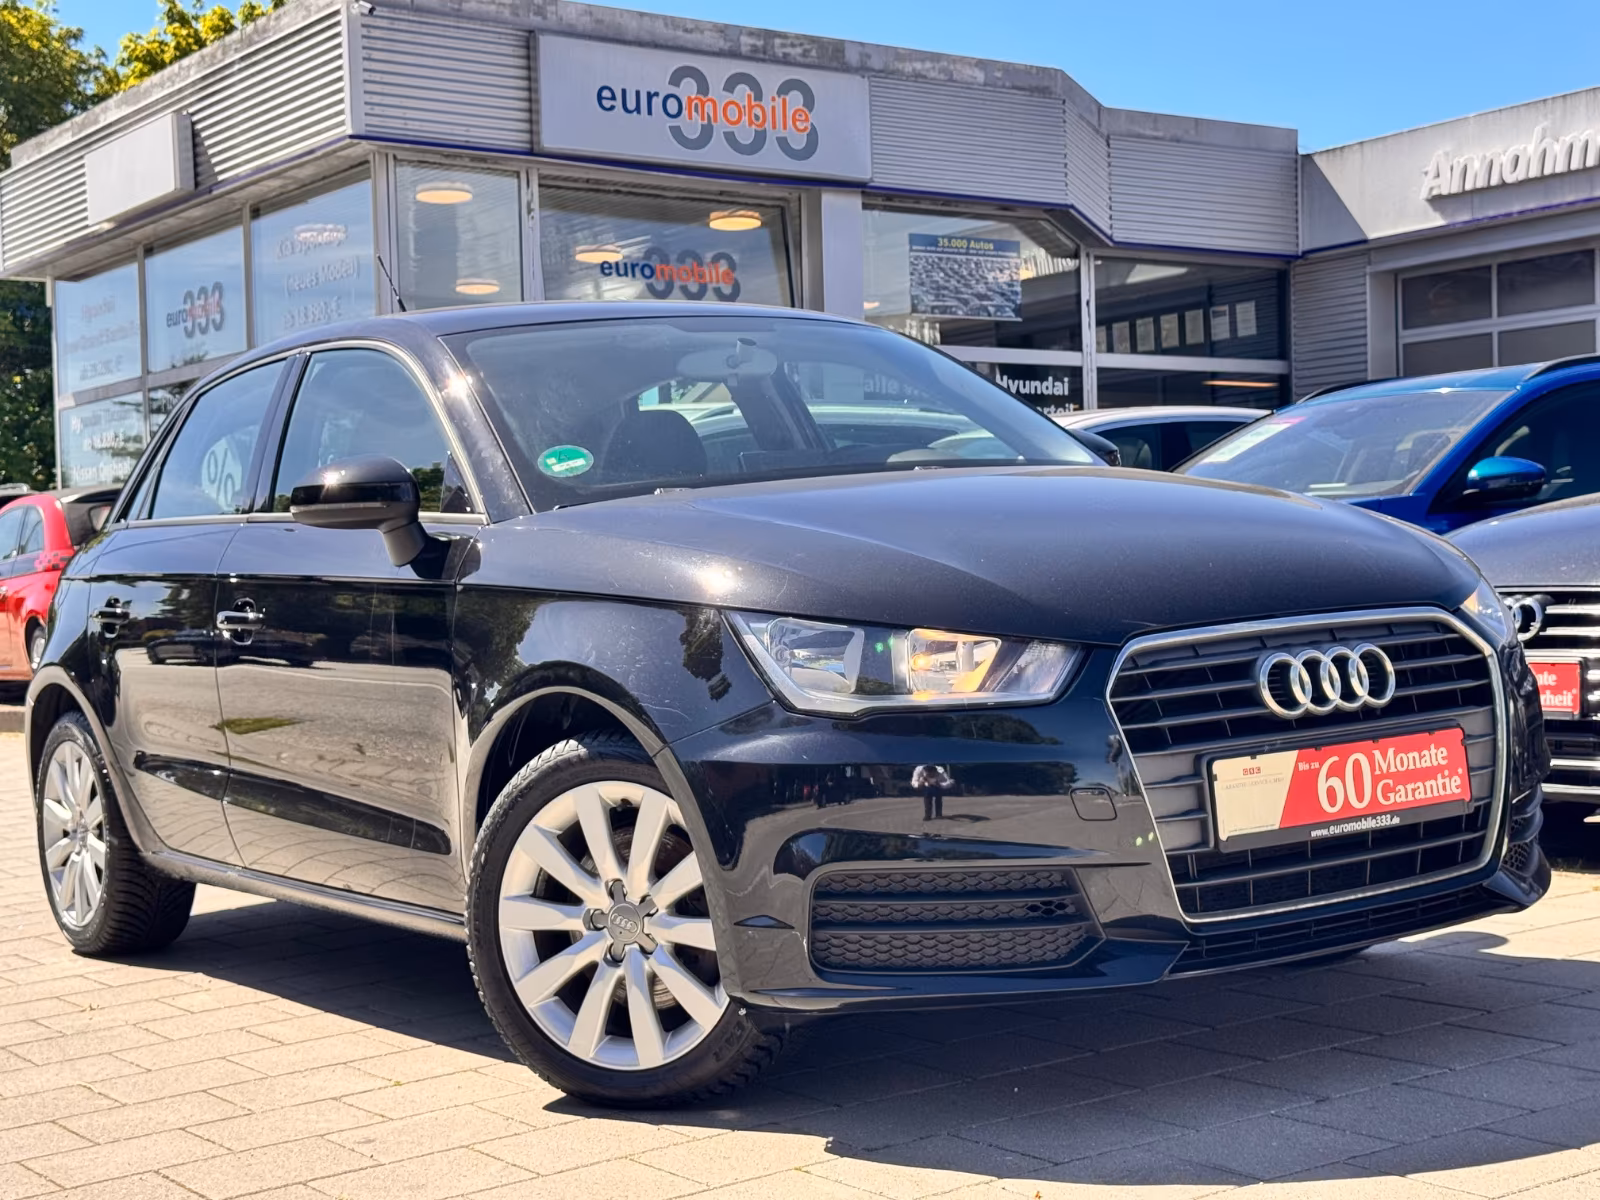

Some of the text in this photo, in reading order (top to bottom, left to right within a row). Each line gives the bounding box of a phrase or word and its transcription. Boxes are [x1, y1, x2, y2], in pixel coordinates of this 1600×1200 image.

[596, 84, 811, 134] euromobile
[667, 65, 820, 162] 333
[1420, 122, 1600, 201] Annahm
[937, 237, 994, 250] 35.000 Autos
[600, 259, 735, 286] euromobile
[642, 245, 741, 303] 333
[183, 281, 225, 339] 333
[1297, 762, 1320, 772] Bis zu
[1317, 752, 1373, 814] 60
[1372, 743, 1448, 775] Monate
[1310, 814, 1401, 838] www.euromobile333.de
